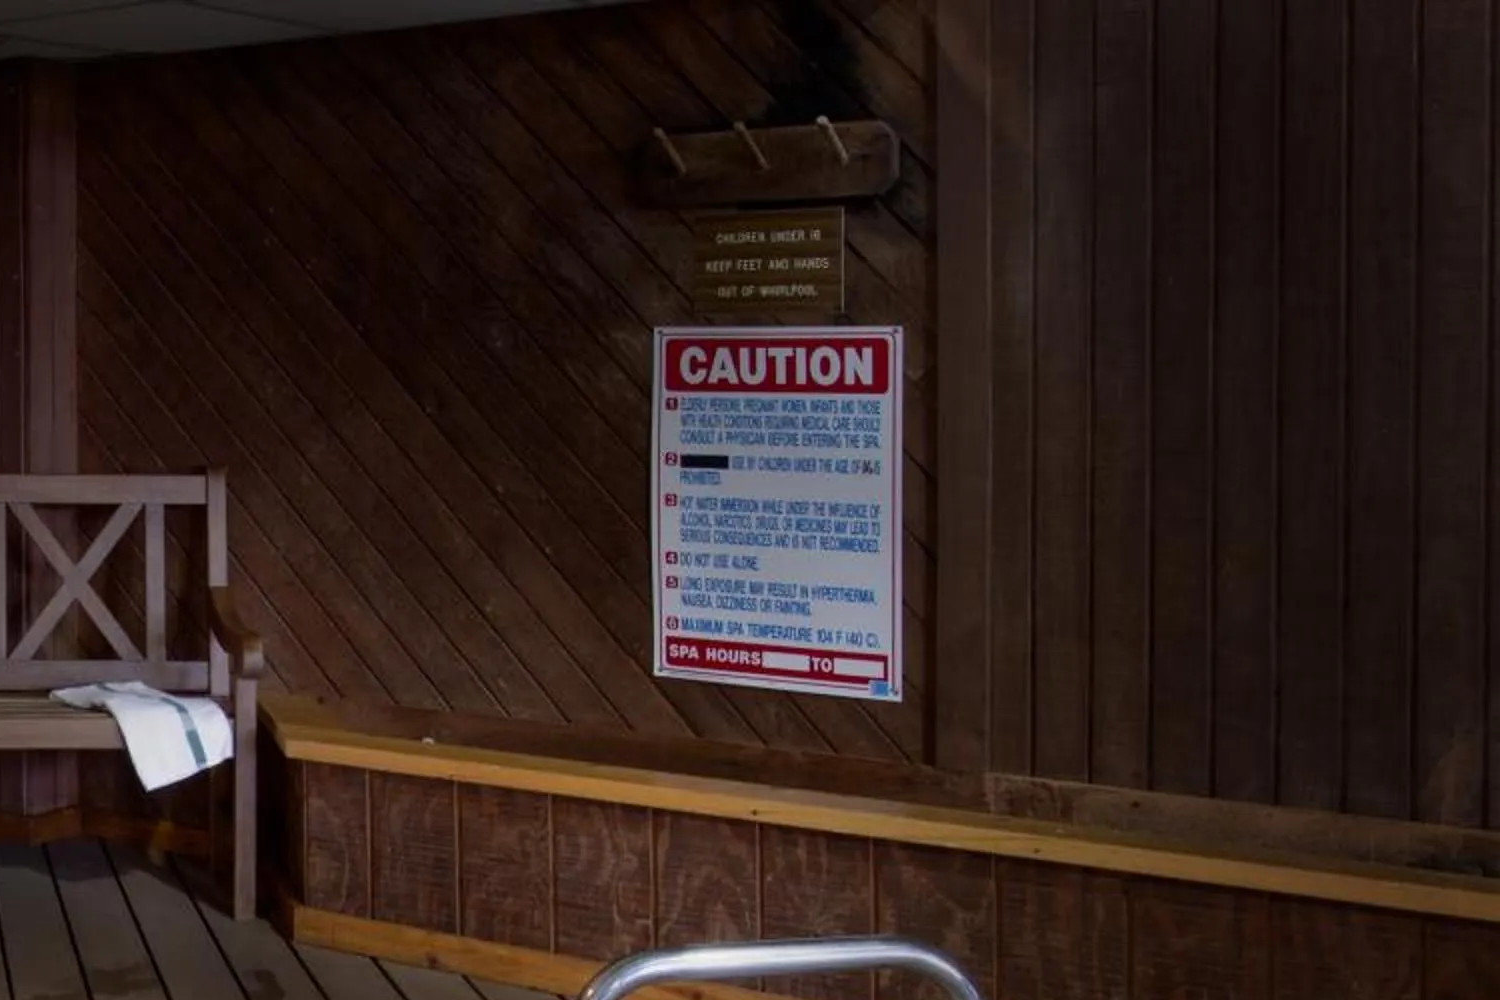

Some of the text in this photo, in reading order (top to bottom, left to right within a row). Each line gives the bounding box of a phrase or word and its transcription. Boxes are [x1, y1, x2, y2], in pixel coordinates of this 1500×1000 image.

[715, 232, 765, 244] CHILDREN
[770, 230, 805, 243] UNDER
[705, 257, 829, 272] KEEP FEET AND HANDS
[717, 286, 738, 298] OUT
[741, 285, 755, 297] OF
[679, 345, 873, 386] CAUTION
[859, 401, 881, 415] THOSE
[724, 415, 763, 429] CONDITIONS
[802, 417, 831, 431] MEDICAL
[833, 418, 852, 432] CARE
[854, 418, 880, 433] SHOULD
[680, 431, 715, 445] CONSULT
[726, 431, 766, 446] PHYSICIAN
[768, 432, 799, 447] BEFORE
[802, 433, 841, 448] ENTERING
[845, 434, 860, 449] THE
[819, 459, 833, 473] THE
[835, 459, 849, 474] AGE
[851, 460, 861, 474] OF
[812, 501, 825, 515] THE
[828, 502, 868, 516] INFLUENCE
[870, 503, 881, 517] OF
[783, 517, 793, 530] OR
[794, 518, 832, 533] MEDICINES
[834, 520, 849, 534] MAY
[851, 520, 869, 535] LEAD
[871, 521, 881, 536] TO
[713, 530, 772, 547] CONSEQUENCES
[775, 534, 790, 548] AND
[801, 536, 817, 549] NOT
[680, 552, 692, 567] DO
[694, 553, 711, 568] NOT
[713, 555, 730, 569] USE
[705, 577, 747, 593] EXPOSURE
[749, 580, 765, 594] MAY
[767, 581, 797, 598] RESULT
[800, 583, 810, 598] IN
[716, 596, 756, 611] DIZZINESS
[759, 598, 772, 612] OR
[681, 617, 723, 633] MAXIMUM
[727, 620, 745, 635] SPA
[747, 623, 813, 643] TEMPERATURE
[816, 627, 834, 643] 104
[669, 643, 833, 672] SPA HOURS TO
